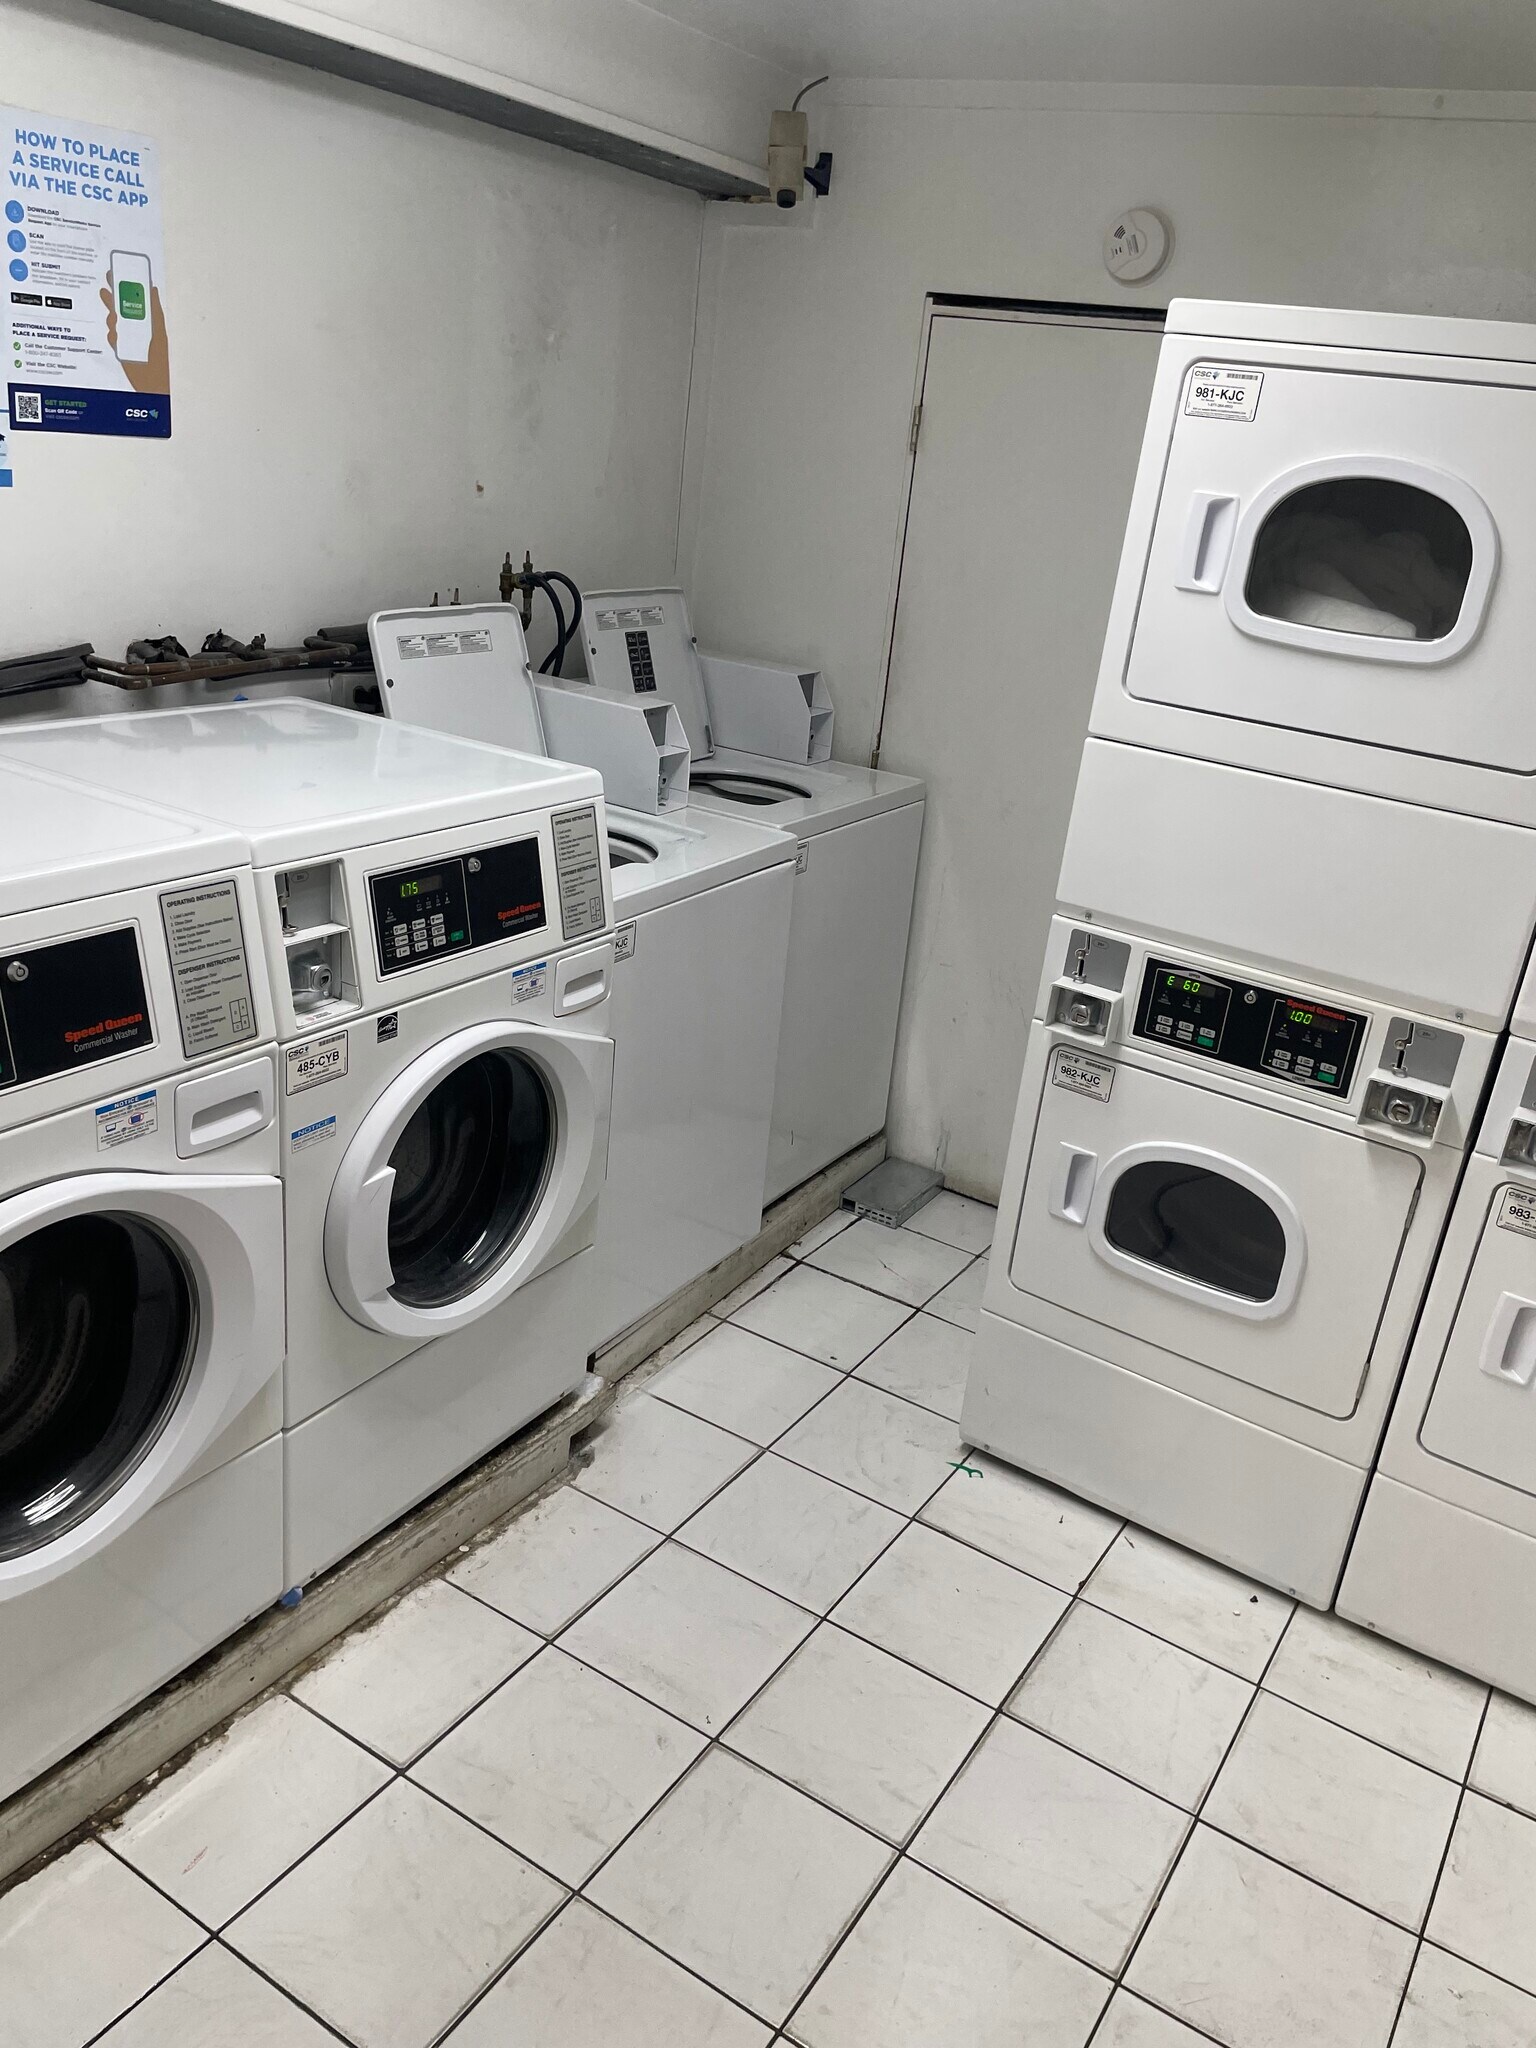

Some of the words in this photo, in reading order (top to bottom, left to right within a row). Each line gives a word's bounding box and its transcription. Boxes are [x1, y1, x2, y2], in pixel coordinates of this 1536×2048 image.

[15, 128, 57, 150] HOW
[62, 138, 85, 155] TO
[89, 143, 140, 167] PLACE
[12, 150, 25, 167] A
[29, 152, 100, 180] SERVICE
[104, 167, 145, 188] CALL
[9, 170, 39, 190] VIA
[44, 176, 77, 196] THE
[81, 183, 113, 202] CSC
[117, 190, 149, 208] APP
[27, 206, 60, 216] DOWNLOAD
[122, 300, 142, 309] Service
[12, 322, 46, 331] ADDITIONAL
[36, 332, 60, 340] SERVICE
[1194, 370, 1212, 378] CSC
[1195, 386, 1245, 401] 981-KJC
[125, 408, 148, 418] CSC
[166, 896, 195, 908] OPERATING
[196, 889, 231, 902] INSTRUCTIONS
[497, 906, 520, 920] Speed
[520, 901, 541, 913] Queen
[177, 963, 206, 976] DISPENSER
[206, 954, 240, 968] INSTRUCTIONS
[1167, 975, 1176, 986] E
[1183, 980, 1201, 993] 60
[1286, 999, 1316, 1013] Speed
[1316, 1007, 1346, 1021] Queen
[64, 1022, 104, 1042] Speed
[105, 1013, 143, 1030] Queen
[73, 1034, 113, 1053] Commercial
[114, 1027, 138, 1041] Washer
[288, 1047, 304, 1058] CSC
[297, 1050, 340, 1073] 485-CYB
[1060, 1065, 1101, 1085] 982-KJC
[114, 1096, 139, 1109] NOTICE
[297, 1120, 329, 1137] NOTICE
[1508, 1191, 1527, 1200] CSC
